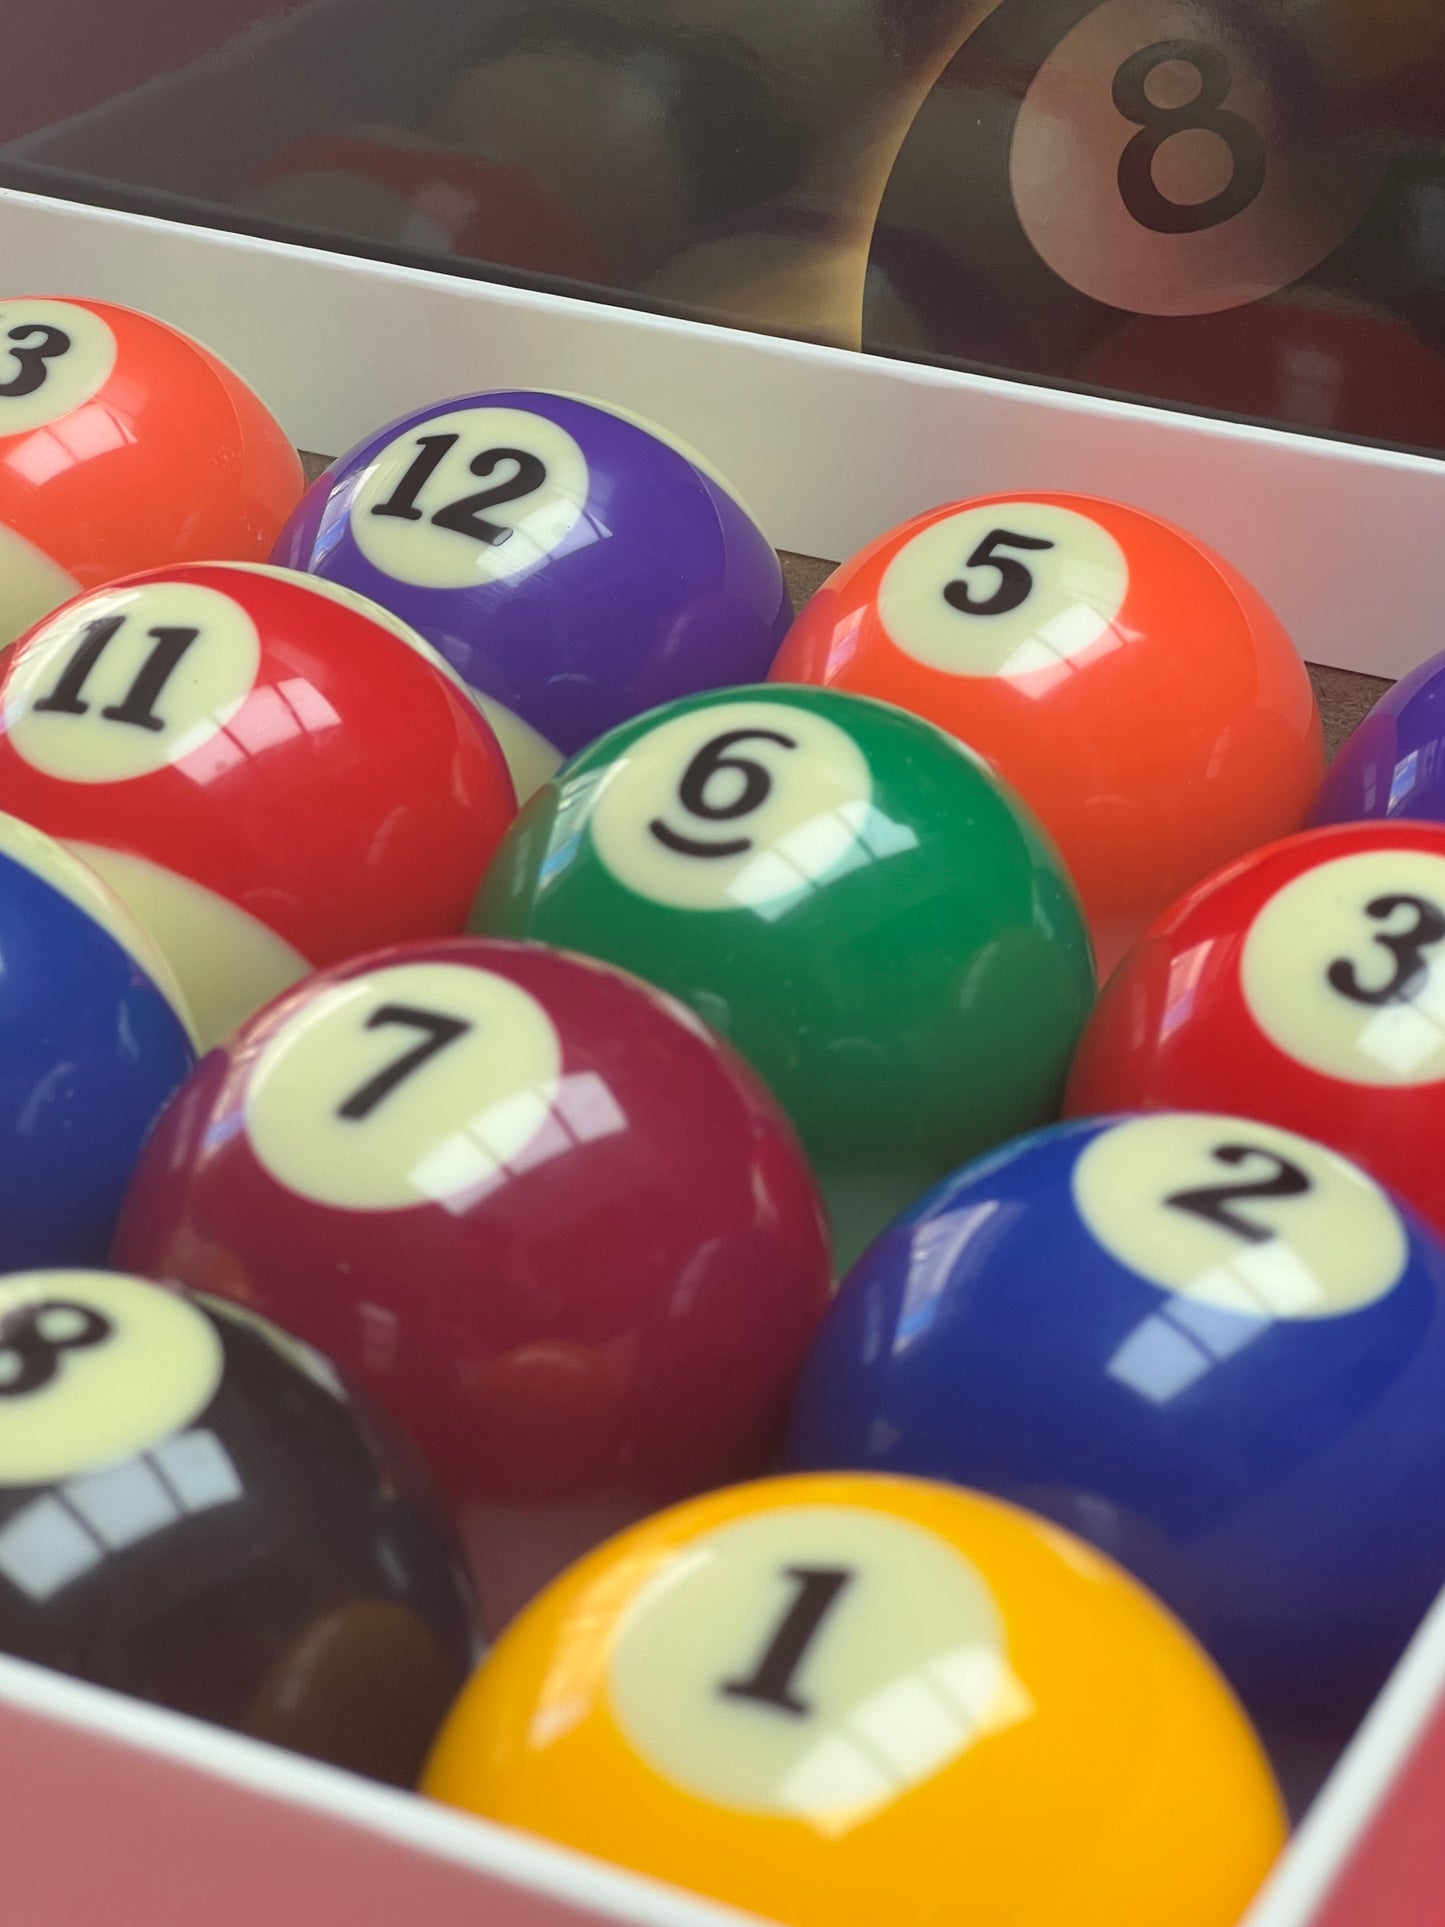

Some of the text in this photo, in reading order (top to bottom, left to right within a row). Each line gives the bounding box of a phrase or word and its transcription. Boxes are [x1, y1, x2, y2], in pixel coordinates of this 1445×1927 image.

[1111, 38, 1267, 235] 8
[0, 324, 71, 397] 3
[370, 433, 546, 547] 12
[943, 528, 1055, 616] 5
[32, 615, 201, 732] 11
[678, 728, 798, 821] 6
[1326, 892, 1445, 1006] 3
[335, 1003, 473, 1123] 7
[1163, 1144, 1312, 1245] 2
[717, 1565, 856, 1719] 1
